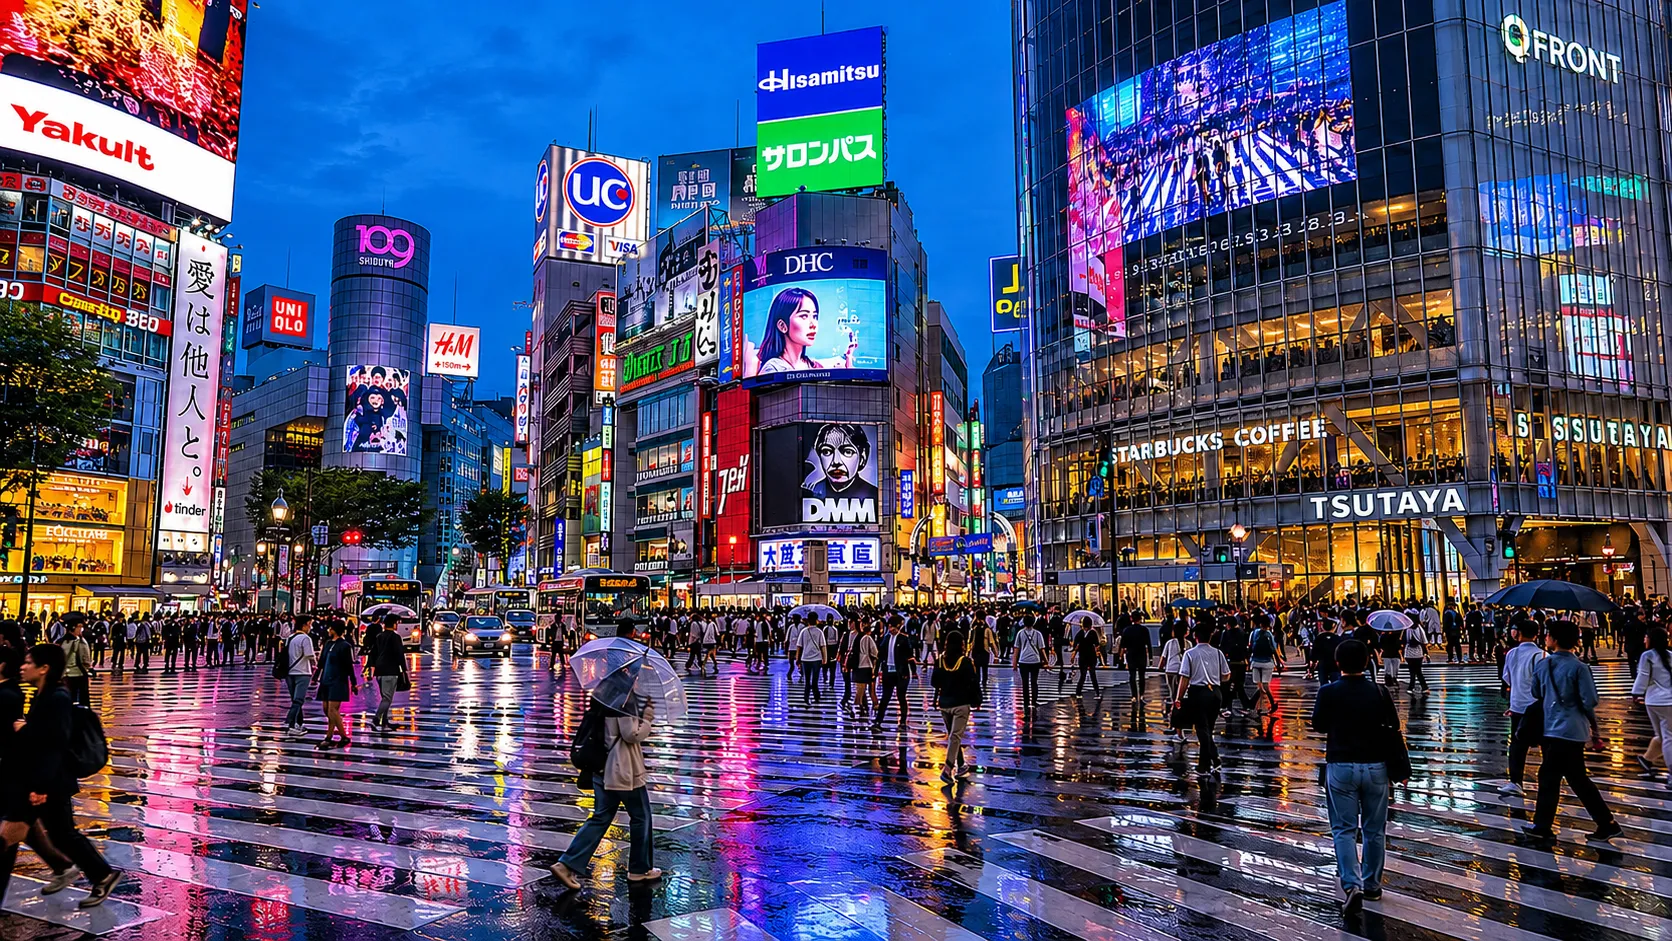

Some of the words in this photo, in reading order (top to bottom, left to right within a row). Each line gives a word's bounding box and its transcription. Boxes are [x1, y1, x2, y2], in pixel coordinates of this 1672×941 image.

[758, 64, 879, 92] Hisamitsu
[11, 103, 155, 171] Yakult
[762, 134, 877, 171] サロンパス
[355, 224, 415, 269] 109
[608, 240, 639, 255] VISA
[784, 252, 834, 275] DHC
[275, 300, 302, 318] UNI
[274, 315, 304, 333] QLO
[433, 331, 475, 359] H&M
[177, 258, 215, 477] 愛は他人と。
[1111, 431, 1223, 464] STARBUCKS
[1234, 419, 1328, 447] COFFEE
[174, 503, 207, 516] tinder
[802, 498, 877, 522] DMM
[1310, 488, 1466, 519] TSUTAYA
